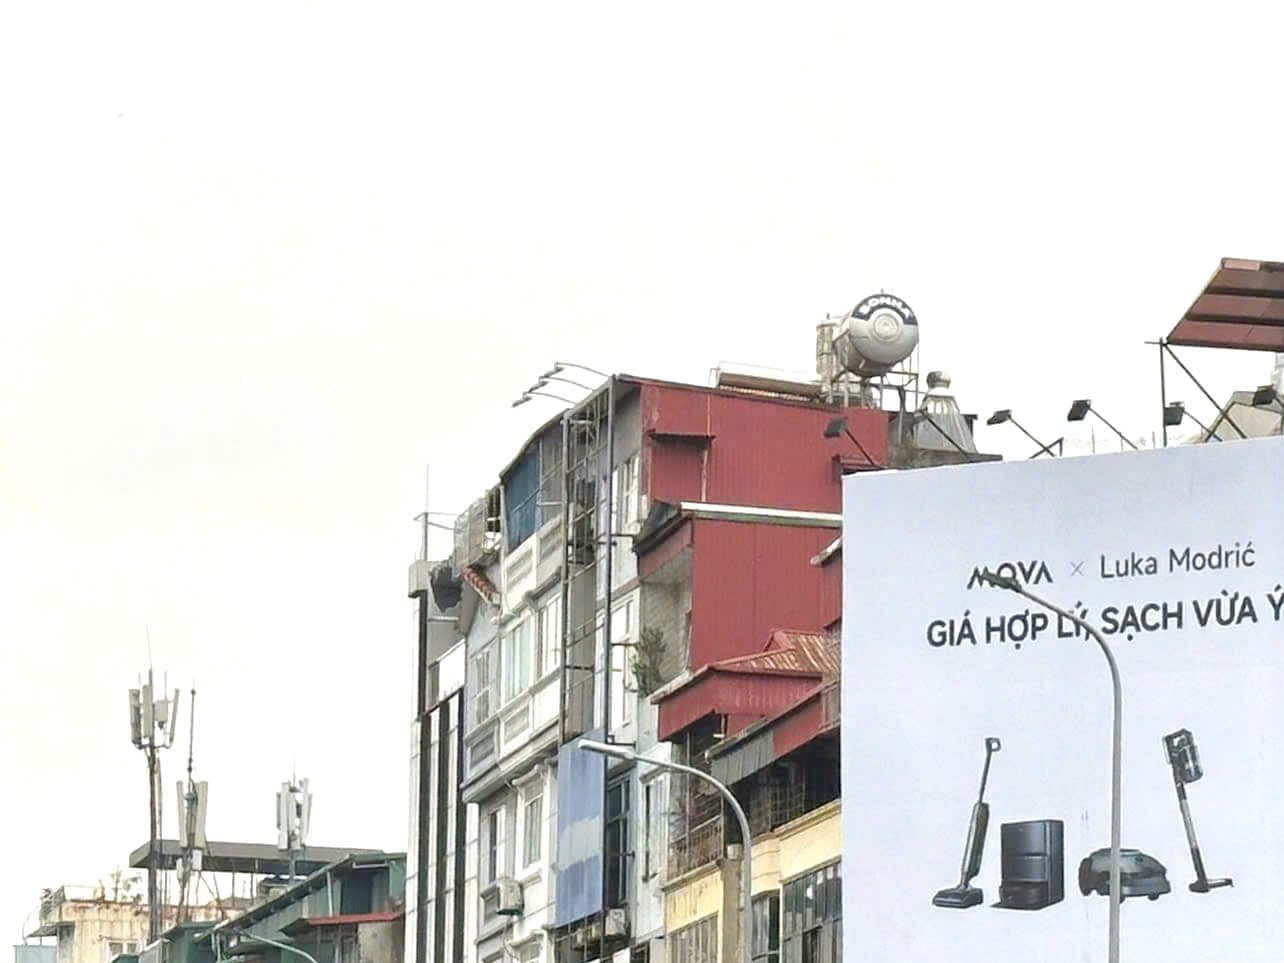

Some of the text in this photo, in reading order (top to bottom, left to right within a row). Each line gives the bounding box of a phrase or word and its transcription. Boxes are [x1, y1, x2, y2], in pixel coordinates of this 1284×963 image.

[1100, 552, 1157, 578] Luka
[1168, 541, 1256, 573] Modrić
[927, 609, 977, 648] GIÁ
[985, 608, 1048, 650] HỢP
[1101, 601, 1183, 641] SẠCH
[1193, 589, 1258, 627] VỪA
